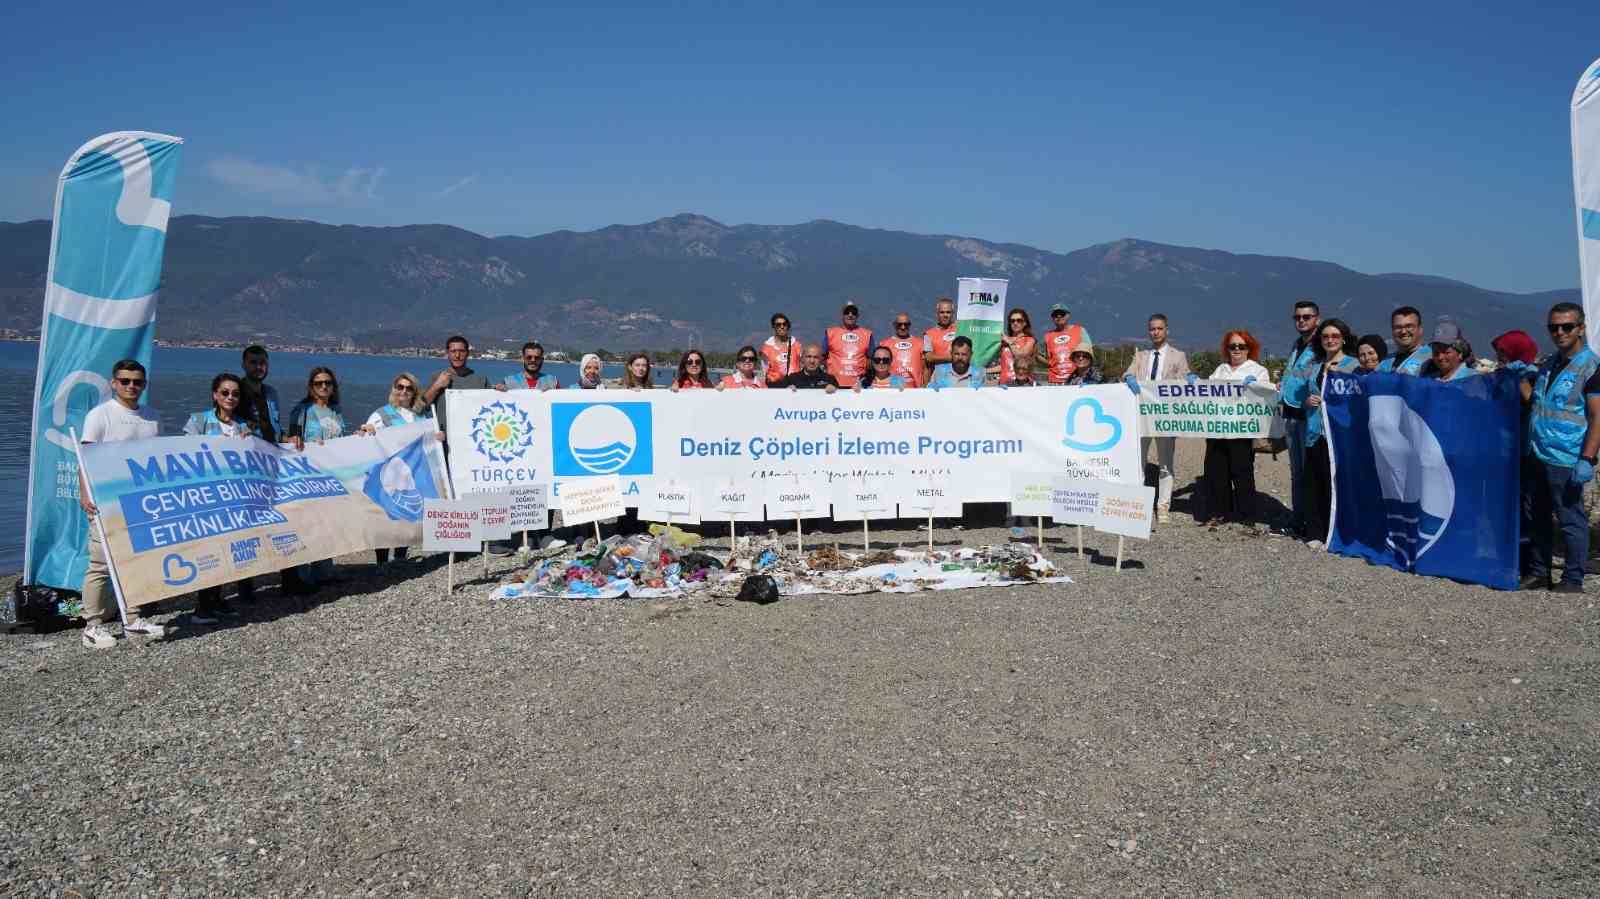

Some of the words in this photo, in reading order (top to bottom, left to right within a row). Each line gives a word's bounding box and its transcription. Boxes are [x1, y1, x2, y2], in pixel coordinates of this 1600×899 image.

[1158, 383, 1244, 397] EDREMİT
[774, 407, 827, 422] Avrupa
[831, 407, 874, 422] Çevre
[878, 407, 925, 422] Ajansı
[1139, 403, 1169, 415] EVRE
[1172, 401, 1219, 416] SAĞLIĞI
[1221, 406, 1234, 416] ve
[1155, 420, 1205, 432] KORUMA
[1207, 418, 1260, 433] DERNEĞİ
[680, 437, 741, 457] Deniz
[748, 437, 830, 461] Çöpleri
[838, 431, 910, 456] İzleme
[918, 436, 1022, 459] Programı
[126, 443, 222, 487] MAVİ
[222, 449, 321, 480] BAYRAK
[471, 466, 536, 485] TÜRÇEV
[141, 488, 217, 520] ÇEVRE
[219, 478, 344, 505] BİLİNÇLENDİRME
[917, 488, 945, 497] METAL
[151, 505, 283, 546] ETKİNLİKLERİ
